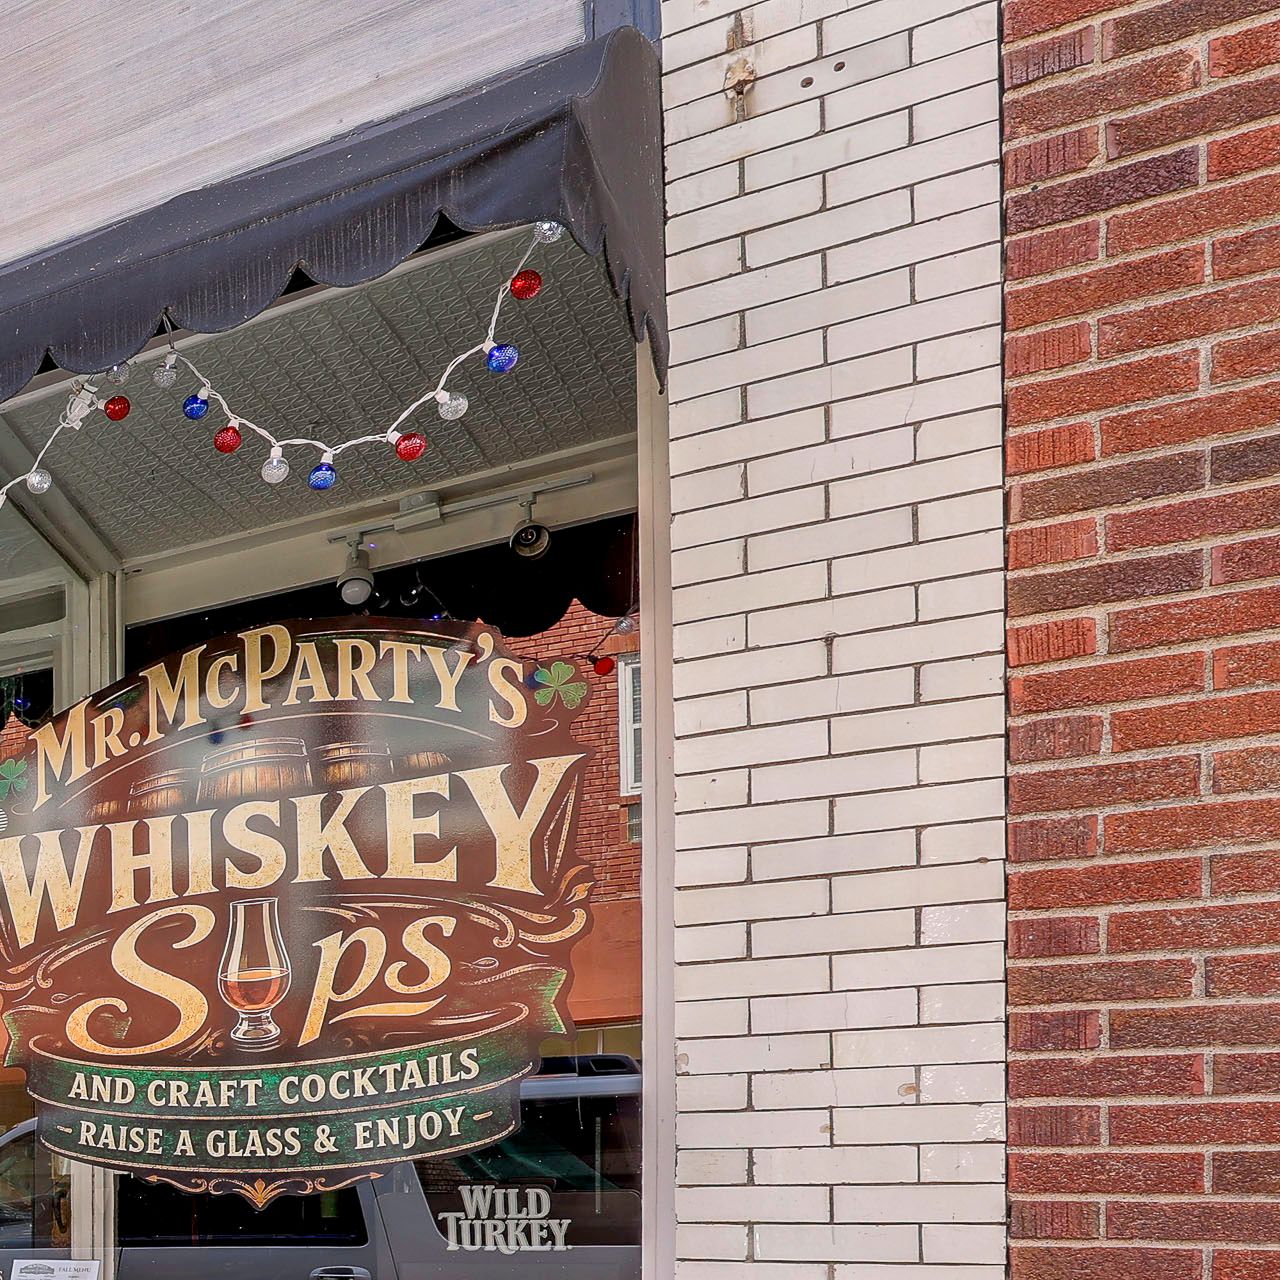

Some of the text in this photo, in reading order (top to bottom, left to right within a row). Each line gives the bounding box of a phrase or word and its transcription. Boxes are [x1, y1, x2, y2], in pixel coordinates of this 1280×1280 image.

[68, 1047, 481, 1108] AND CRAFT COCKTAILS
[77, 1105, 467, 1158] RAISE A GLASS & ENJOY
[457, 1184, 552, 1220] WILD
[437, 1211, 572, 1255] TURKEY
